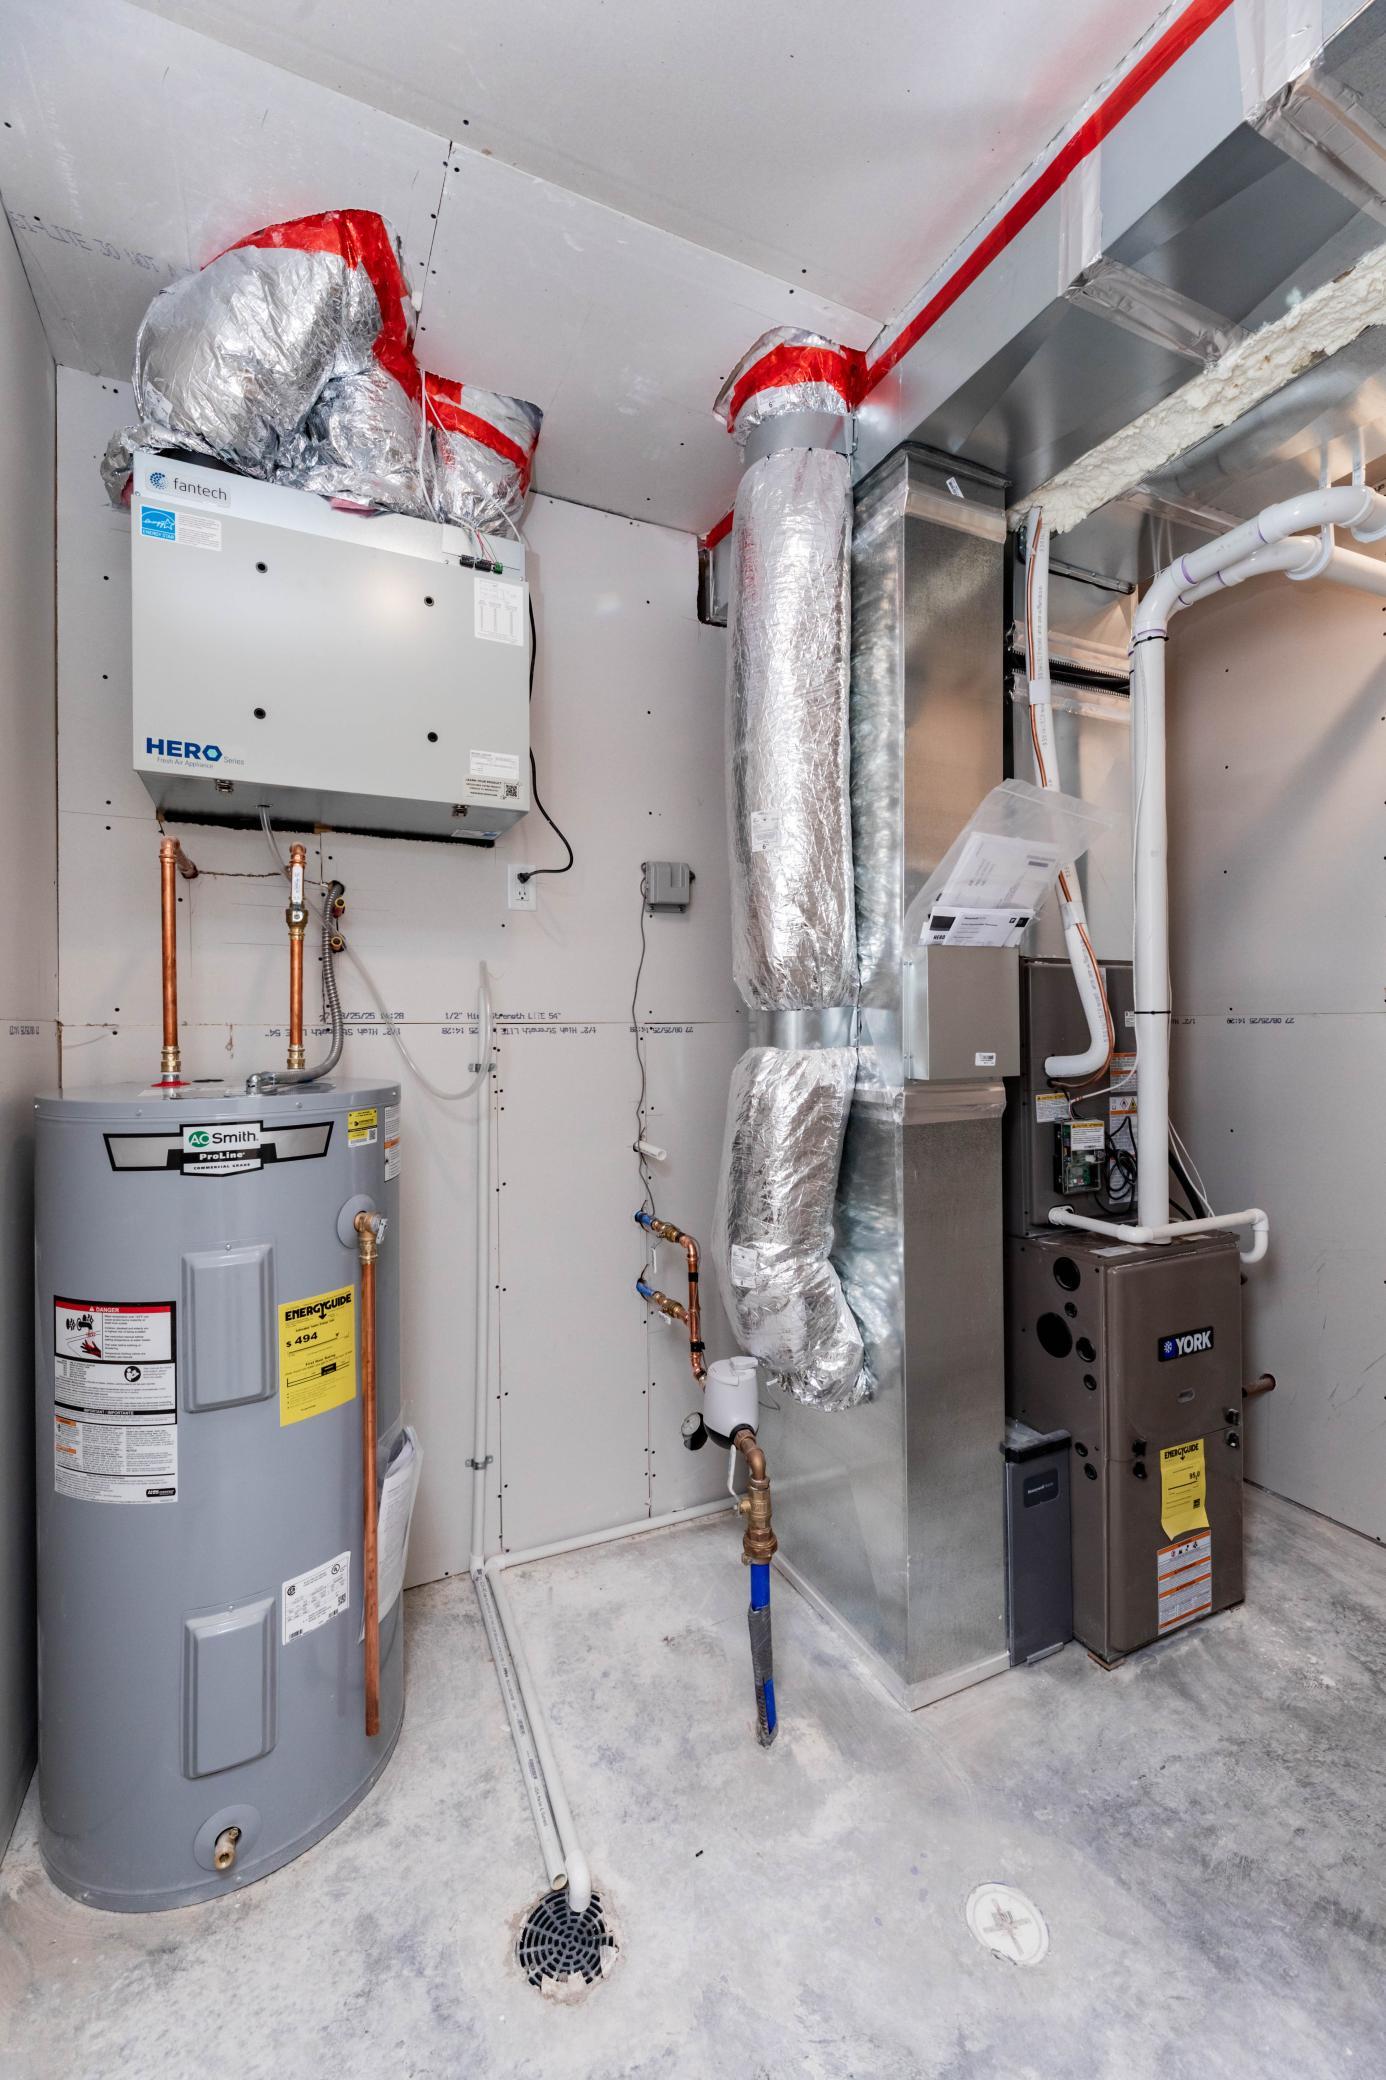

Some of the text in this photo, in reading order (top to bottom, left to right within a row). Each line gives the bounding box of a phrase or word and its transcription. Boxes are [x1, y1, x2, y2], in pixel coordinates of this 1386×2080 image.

[173, 478, 227, 501] fantech
[146, 737, 223, 762] HERO
[212, 1131, 256, 1144] Smith
[199, 1152, 243, 1161] ProLine
[285, 1293, 352, 1321] ENERGYGUIDE
[294, 1332, 318, 1345] 494
[1175, 1330, 1212, 1356] YORK
[1164, 1442, 1199, 1460] ENERGYGUIDE
